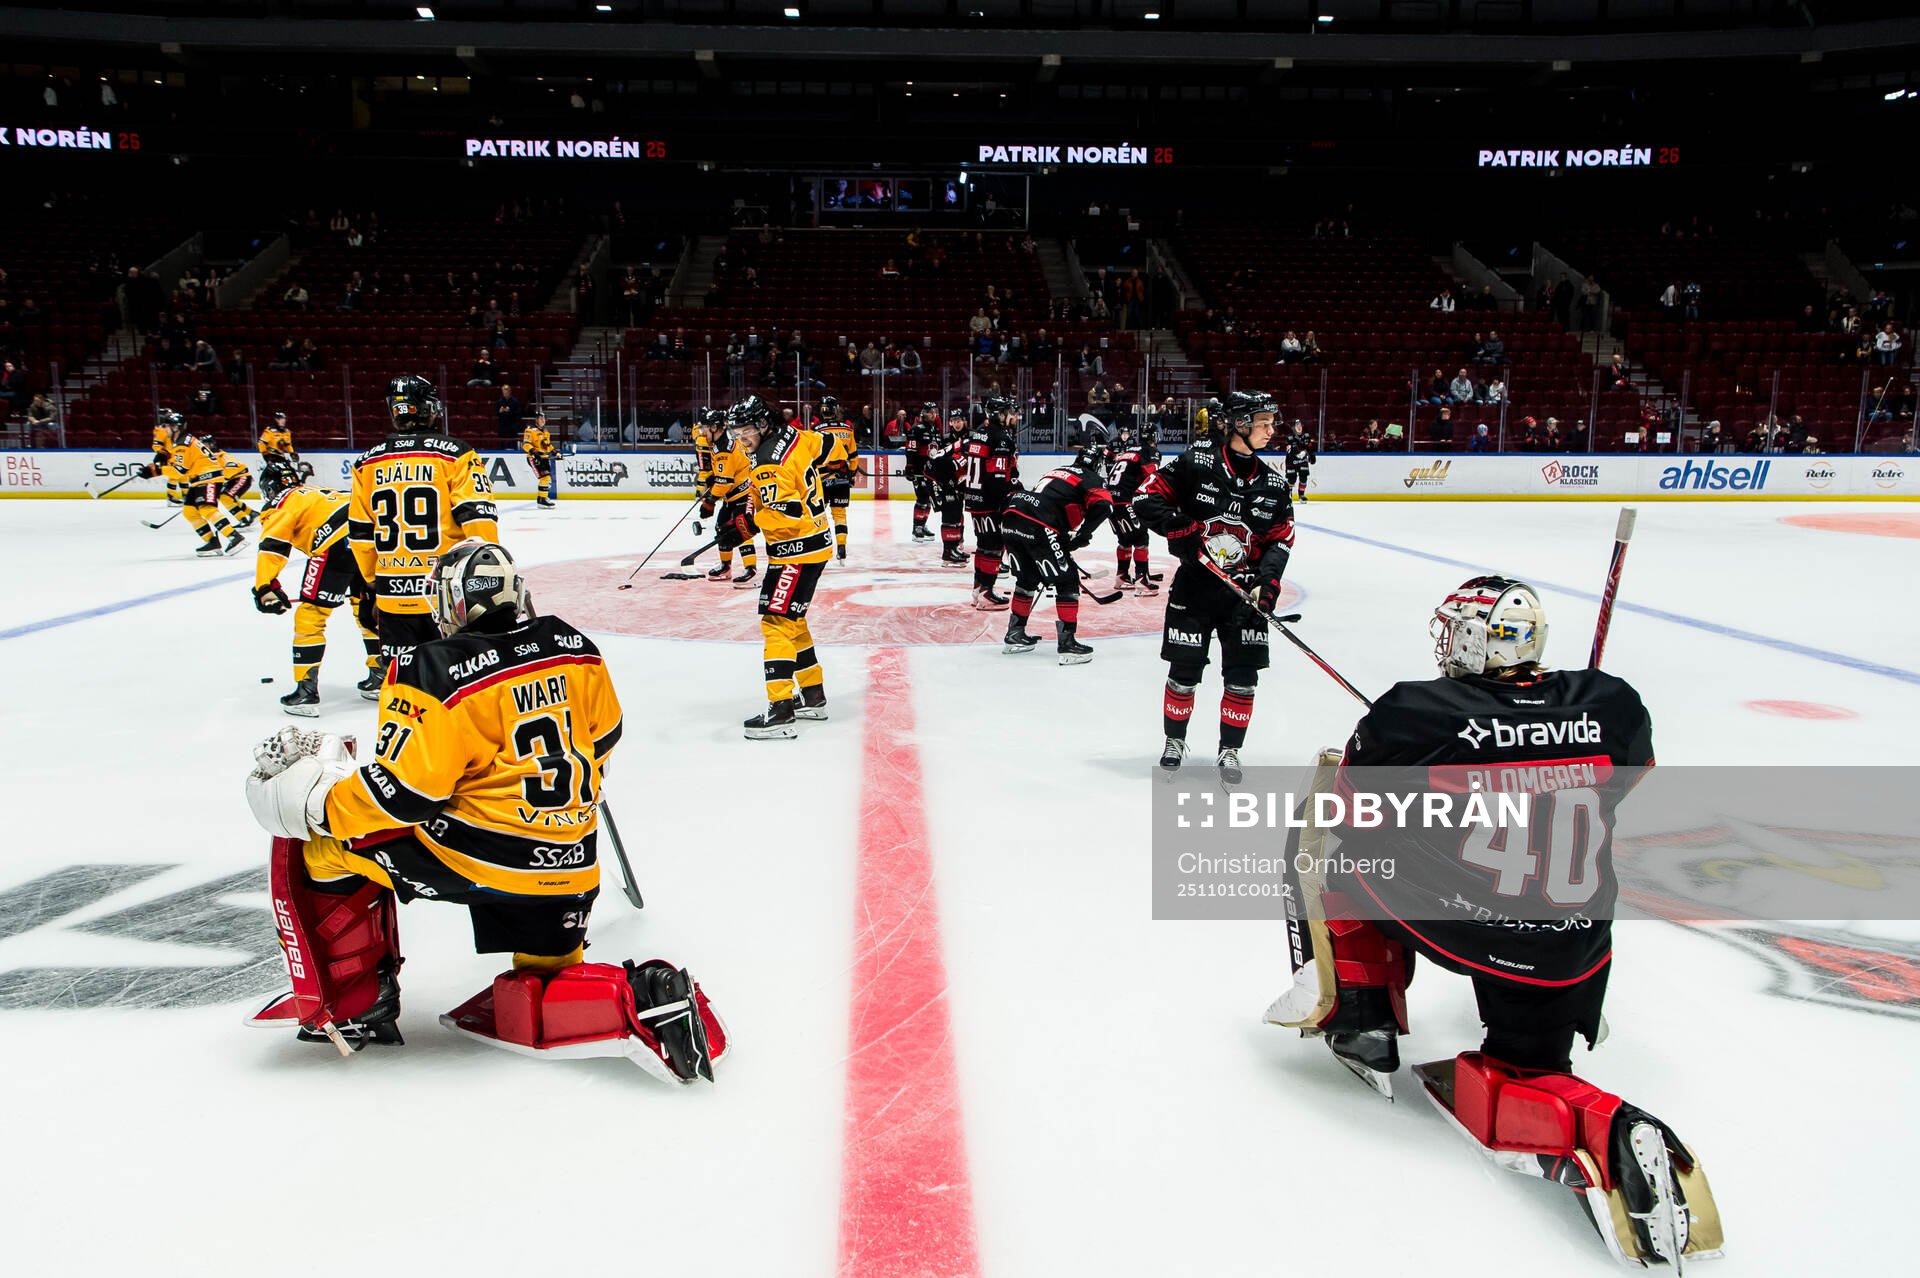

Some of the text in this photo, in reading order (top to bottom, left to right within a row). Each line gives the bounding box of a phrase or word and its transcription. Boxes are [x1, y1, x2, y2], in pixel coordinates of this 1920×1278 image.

[16, 126, 112, 150] NORÉN
[118, 133, 140, 150] 26
[465, 136, 666, 158] PATRIK NORÉN 26
[979, 142, 1173, 164] PATRIK NORÉN 26
[1478, 144, 1680, 167] PATRIK NORÉN 26
[394, 439, 415, 448] SSAB
[7, 456, 41, 470] BAL
[375, 462, 434, 485] SJÄLIN
[1404, 459, 1452, 488] guld
[1562, 465, 1599, 478] ROCK
[1806, 468, 1837, 478] Retro
[1872, 468, 1905, 478] Retro
[8, 472, 44, 486] DER
[472, 473, 492, 494] 39
[566, 472, 616, 483] HOCKEY
[647, 472, 697, 483] HOCKEY
[1559, 478, 1599, 486] KLASSIKER
[1659, 459, 1771, 489] ahlsell
[760, 484, 779, 504] 27
[1196, 493, 1216, 505] DOXA
[370, 485, 442, 553] 39
[776, 541, 804, 556] SSAB
[467, 577, 499, 592] SSAB
[514, 642, 540, 657] SSAB
[460, 649, 500, 679] LKAB
[512, 674, 568, 715] WARD
[1491, 712, 1602, 747] bravida
[375, 720, 413, 763] 31
[529, 843, 585, 868] SSAB
[1459, 787, 1608, 908] 40
